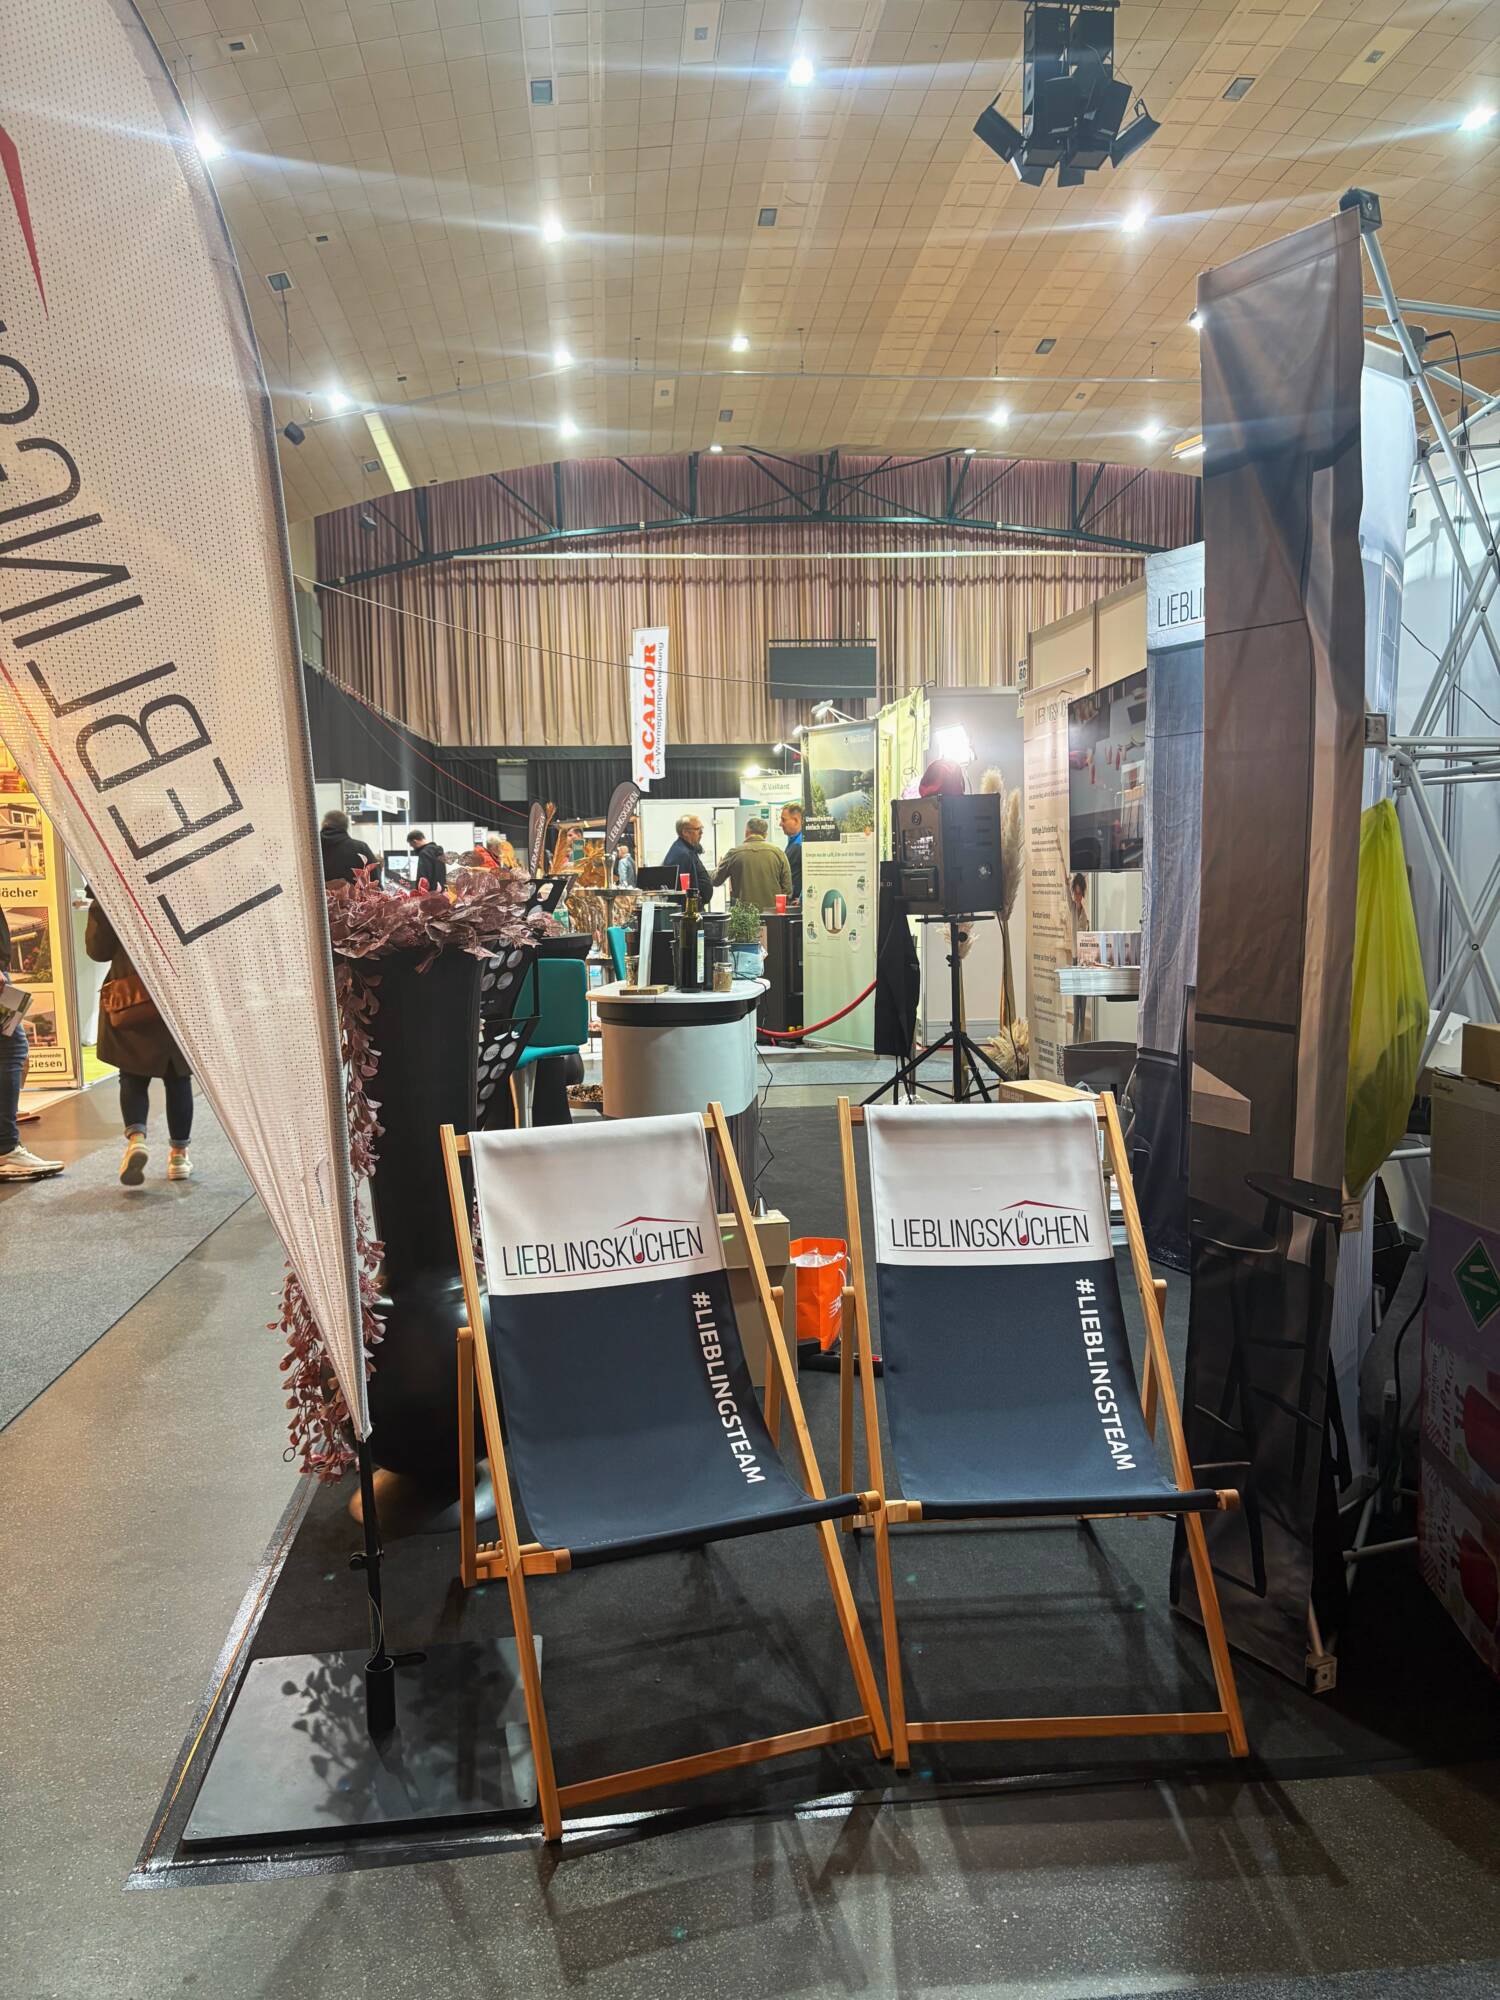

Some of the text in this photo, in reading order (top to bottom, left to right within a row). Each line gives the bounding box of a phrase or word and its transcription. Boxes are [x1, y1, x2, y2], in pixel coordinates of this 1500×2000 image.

[642, 642, 656, 774] ACALOR
[0, 887, 39, 898] ächer
[503, 1224, 705, 1278] LIEBLINGSKÜCHEN
[891, 1208, 1090, 1250] LIEBLINGSKÜCHEN
[691, 1291, 765, 1486] #LIEBLINGSTEAM
[1074, 1278, 1136, 1472] #LIEBLINGSTEAM
